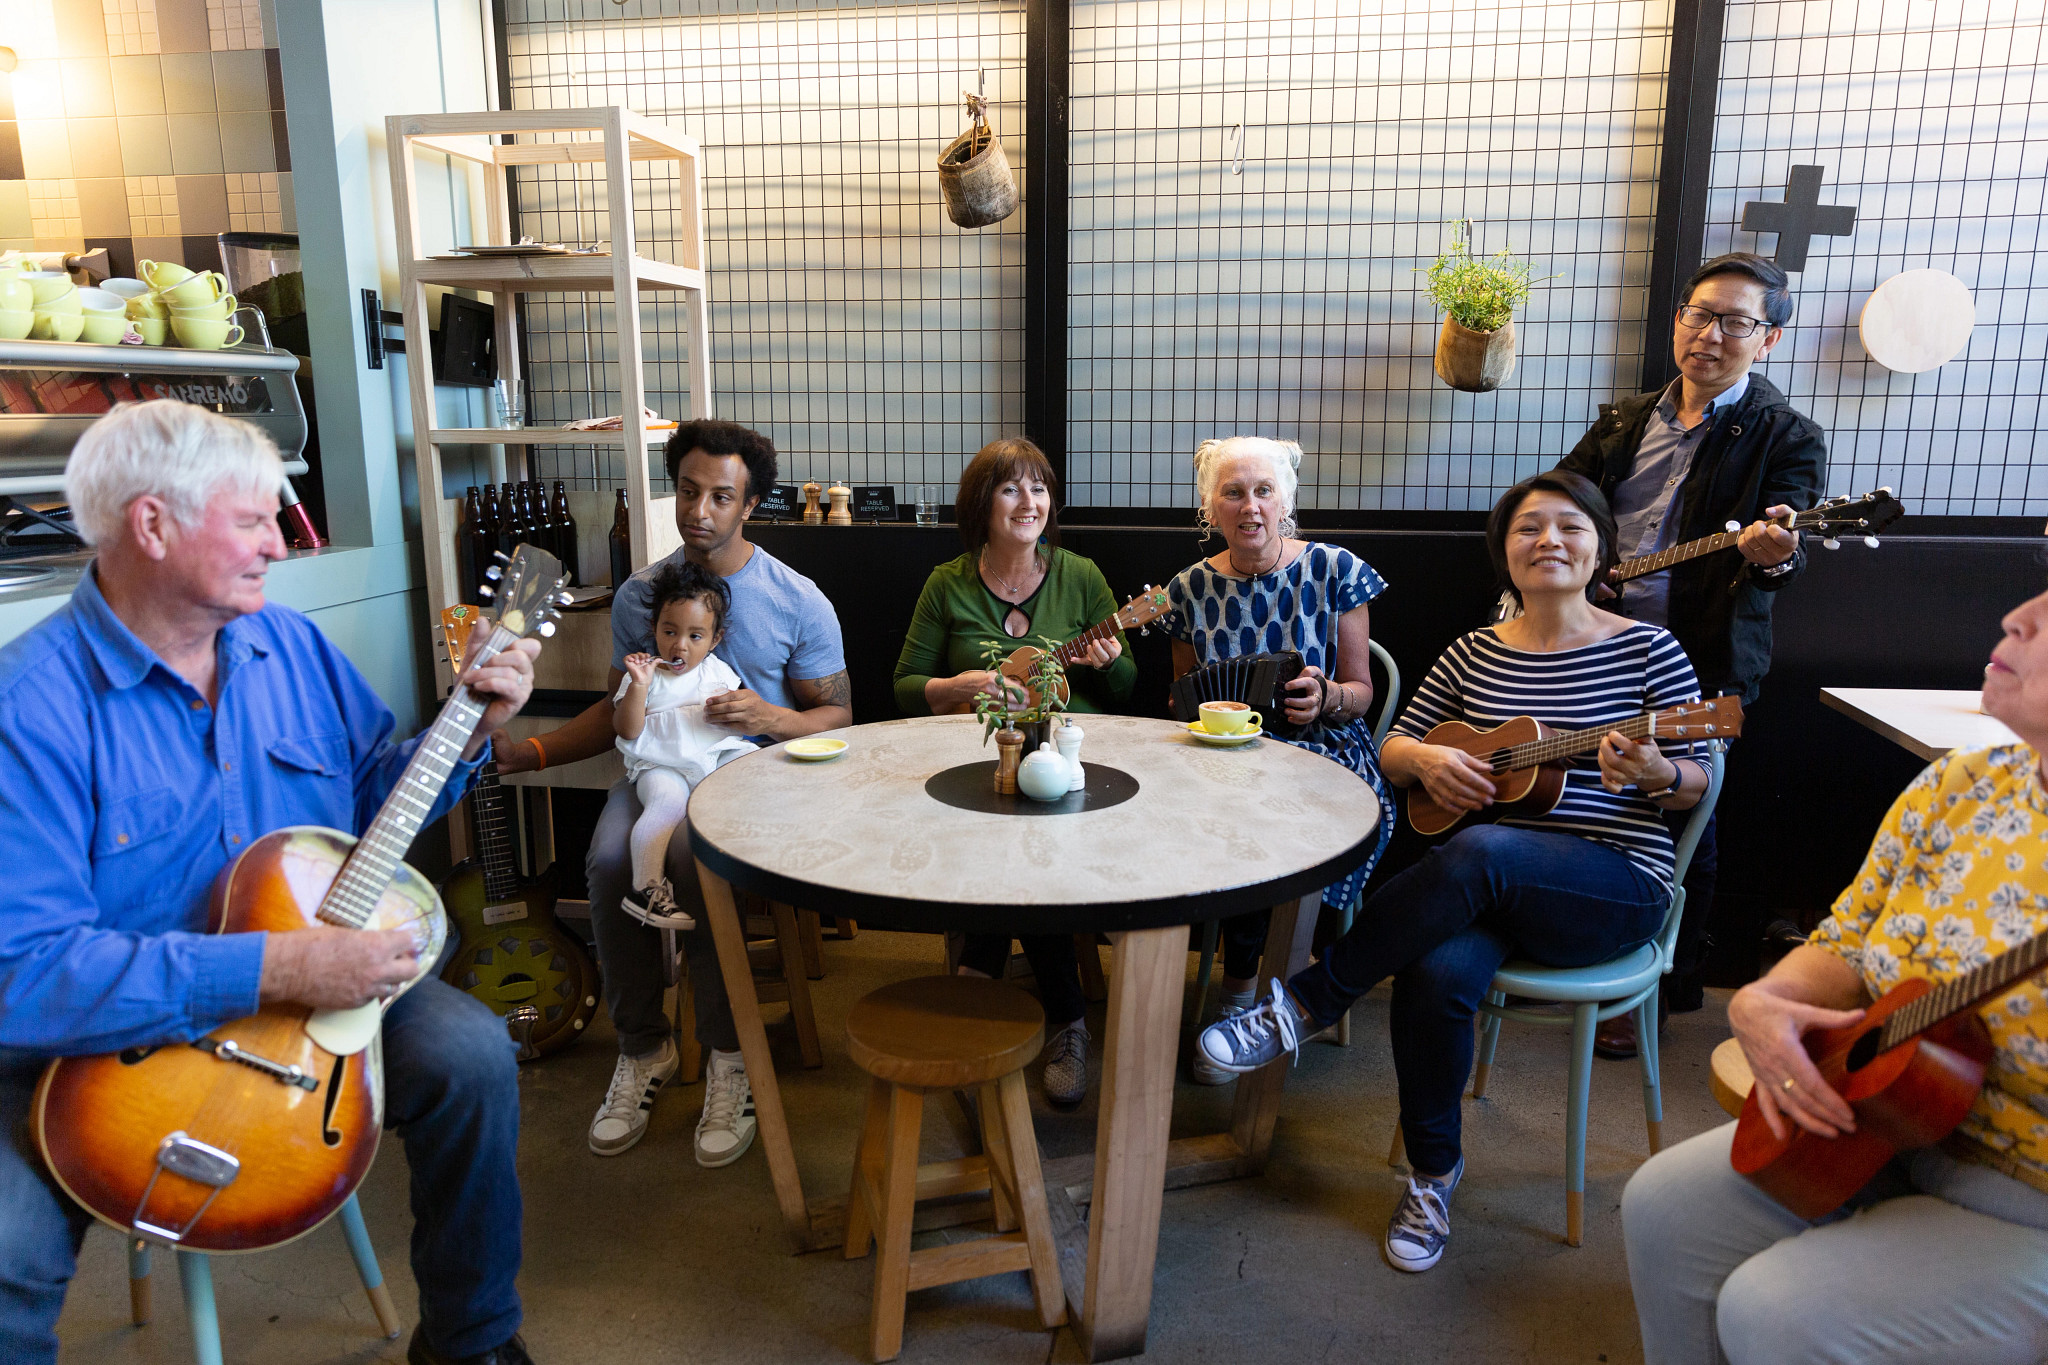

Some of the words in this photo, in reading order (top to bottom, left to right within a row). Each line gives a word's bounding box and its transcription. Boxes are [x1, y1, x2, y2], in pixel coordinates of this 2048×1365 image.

[154, 384, 249, 404] SANREMO
[767, 497, 785, 505] TABLE
[760, 502, 791, 511] RESERVED
